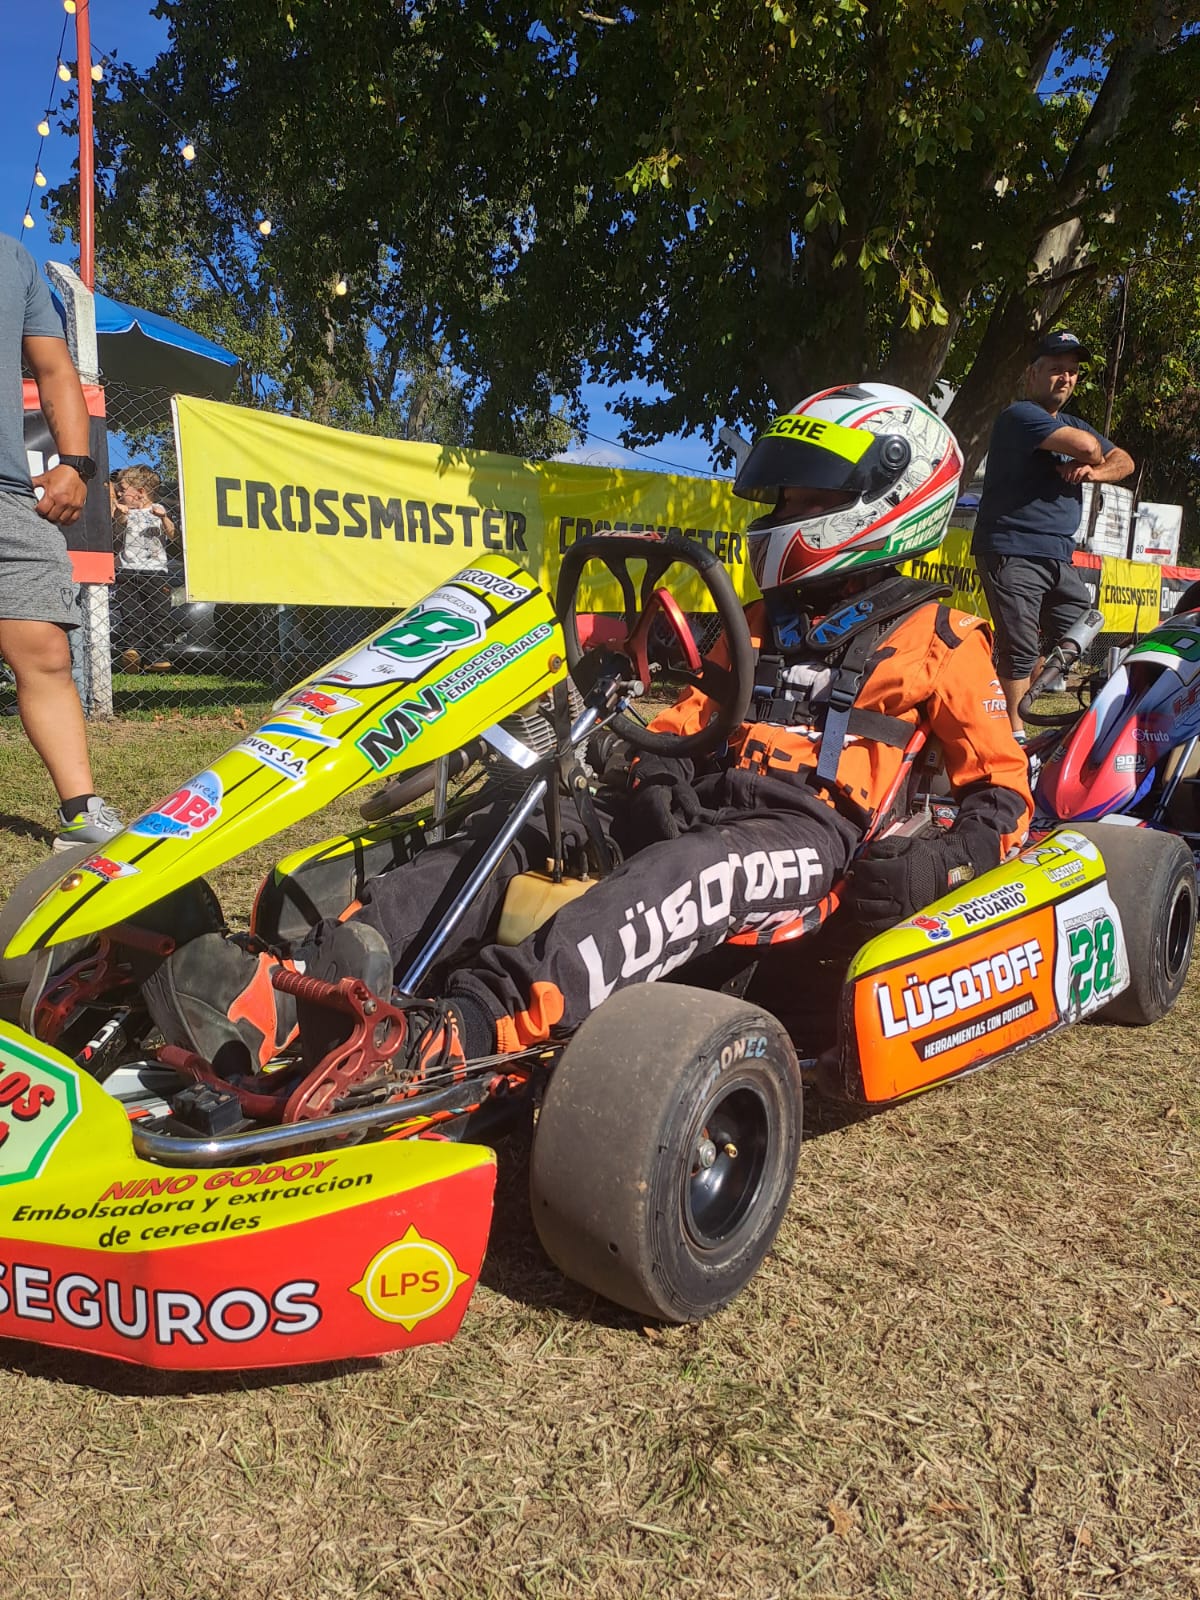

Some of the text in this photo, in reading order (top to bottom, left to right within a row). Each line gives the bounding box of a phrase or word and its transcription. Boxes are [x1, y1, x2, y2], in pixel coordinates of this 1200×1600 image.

[216, 476, 528, 552] CROSSMASTER
[1104, 584, 1158, 607] CROSSMASTER
[437, 643, 504, 691] NEGOCIOS
[448, 624, 552, 700] EMPRESARIALES
[359, 687, 443, 768] MV
[276, 749, 304, 775] S.A.
[941, 882, 1025, 917] Lubricentro
[964, 892, 1026, 925] ACUARIO
[1068, 918, 1115, 1003] 28
[878, 938, 1043, 1038] LÜSQTOFF
[924, 999, 1034, 1059] HERRAMIENTAS CON POTENCIA
[0, 1061, 55, 1121] OS
[12, 1174, 374, 1222] Embolsadora y extraccion
[100, 1158, 338, 1201] NINO GODOY
[98, 1213, 261, 1248] de cereales
[0, 1262, 323, 1345] EGUROS
[379, 1271, 440, 1298] LPS
